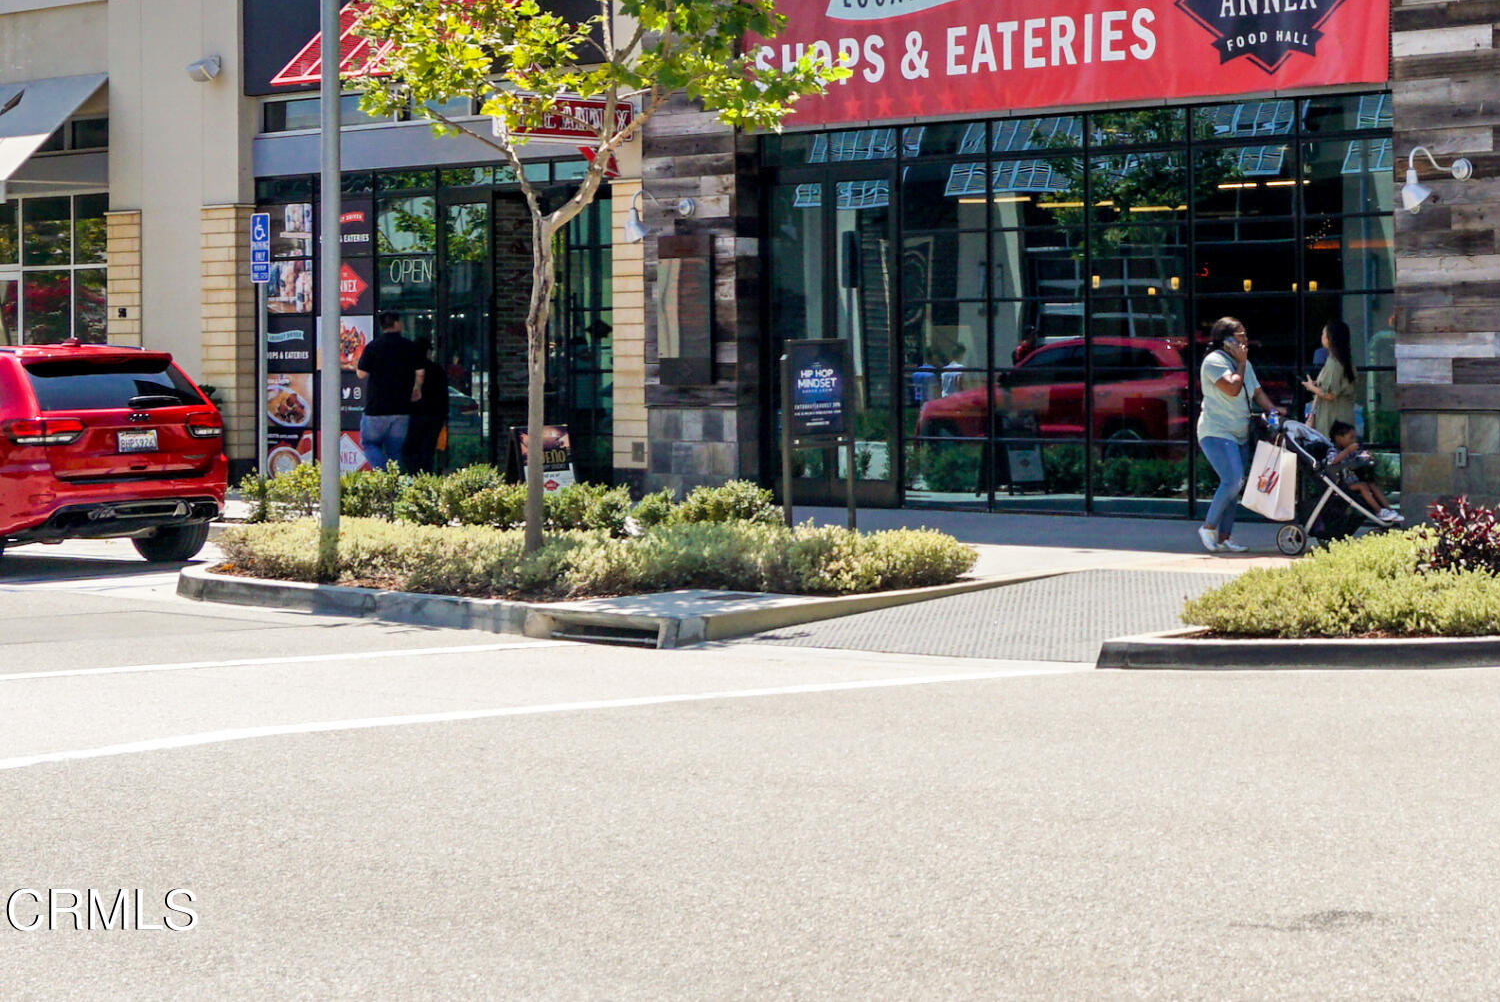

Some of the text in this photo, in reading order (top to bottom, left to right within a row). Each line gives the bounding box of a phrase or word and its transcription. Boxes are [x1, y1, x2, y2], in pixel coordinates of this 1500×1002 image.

[901, 30, 930, 80] &
[946, 8, 1156, 76] EATERIES
[1227, 30, 1309, 51] FOOD HALL
[390, 259, 433, 283] OPEN
[798, 377, 837, 389] MINDSET
[801, 368, 834, 378] HIP HOP
